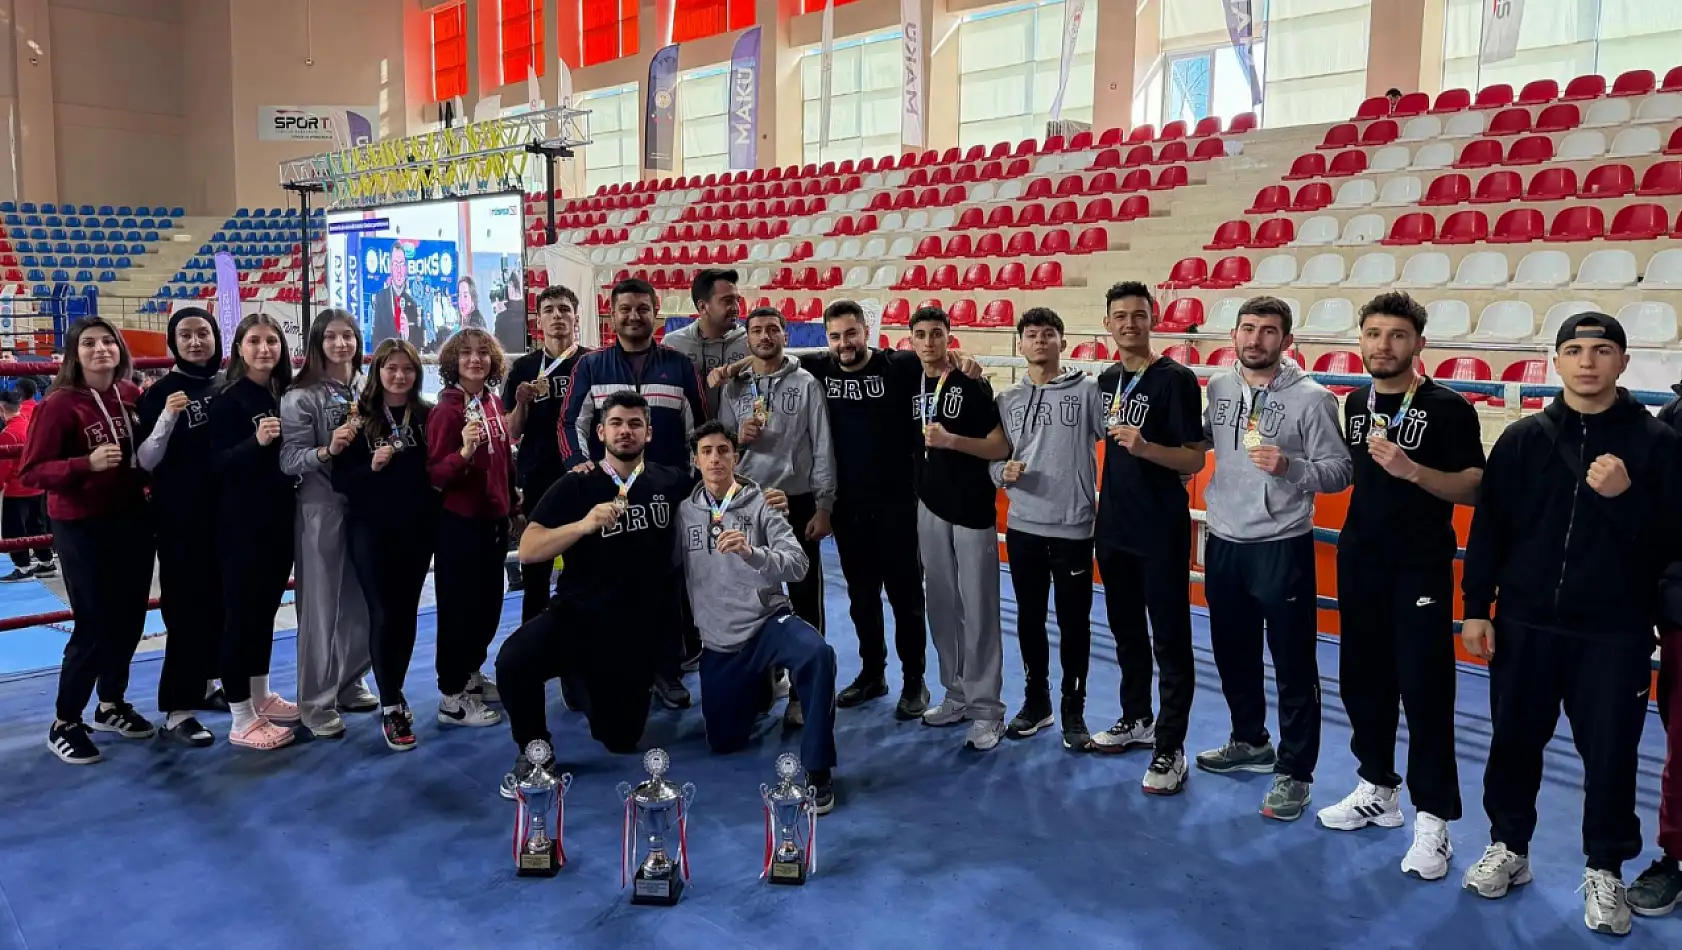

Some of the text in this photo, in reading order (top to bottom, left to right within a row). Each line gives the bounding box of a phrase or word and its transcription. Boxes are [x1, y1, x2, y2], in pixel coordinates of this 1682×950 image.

[274, 116, 331, 129] SPORT
[408, 252, 439, 276] BOKS
[531, 375, 572, 403] ER
[825, 375, 885, 401] ERÜ
[1009, 395, 1081, 433] ERÜ
[1213, 398, 1286, 438] ERÜ
[84, 411, 140, 450] ER
[688, 515, 754, 551] EÜ
